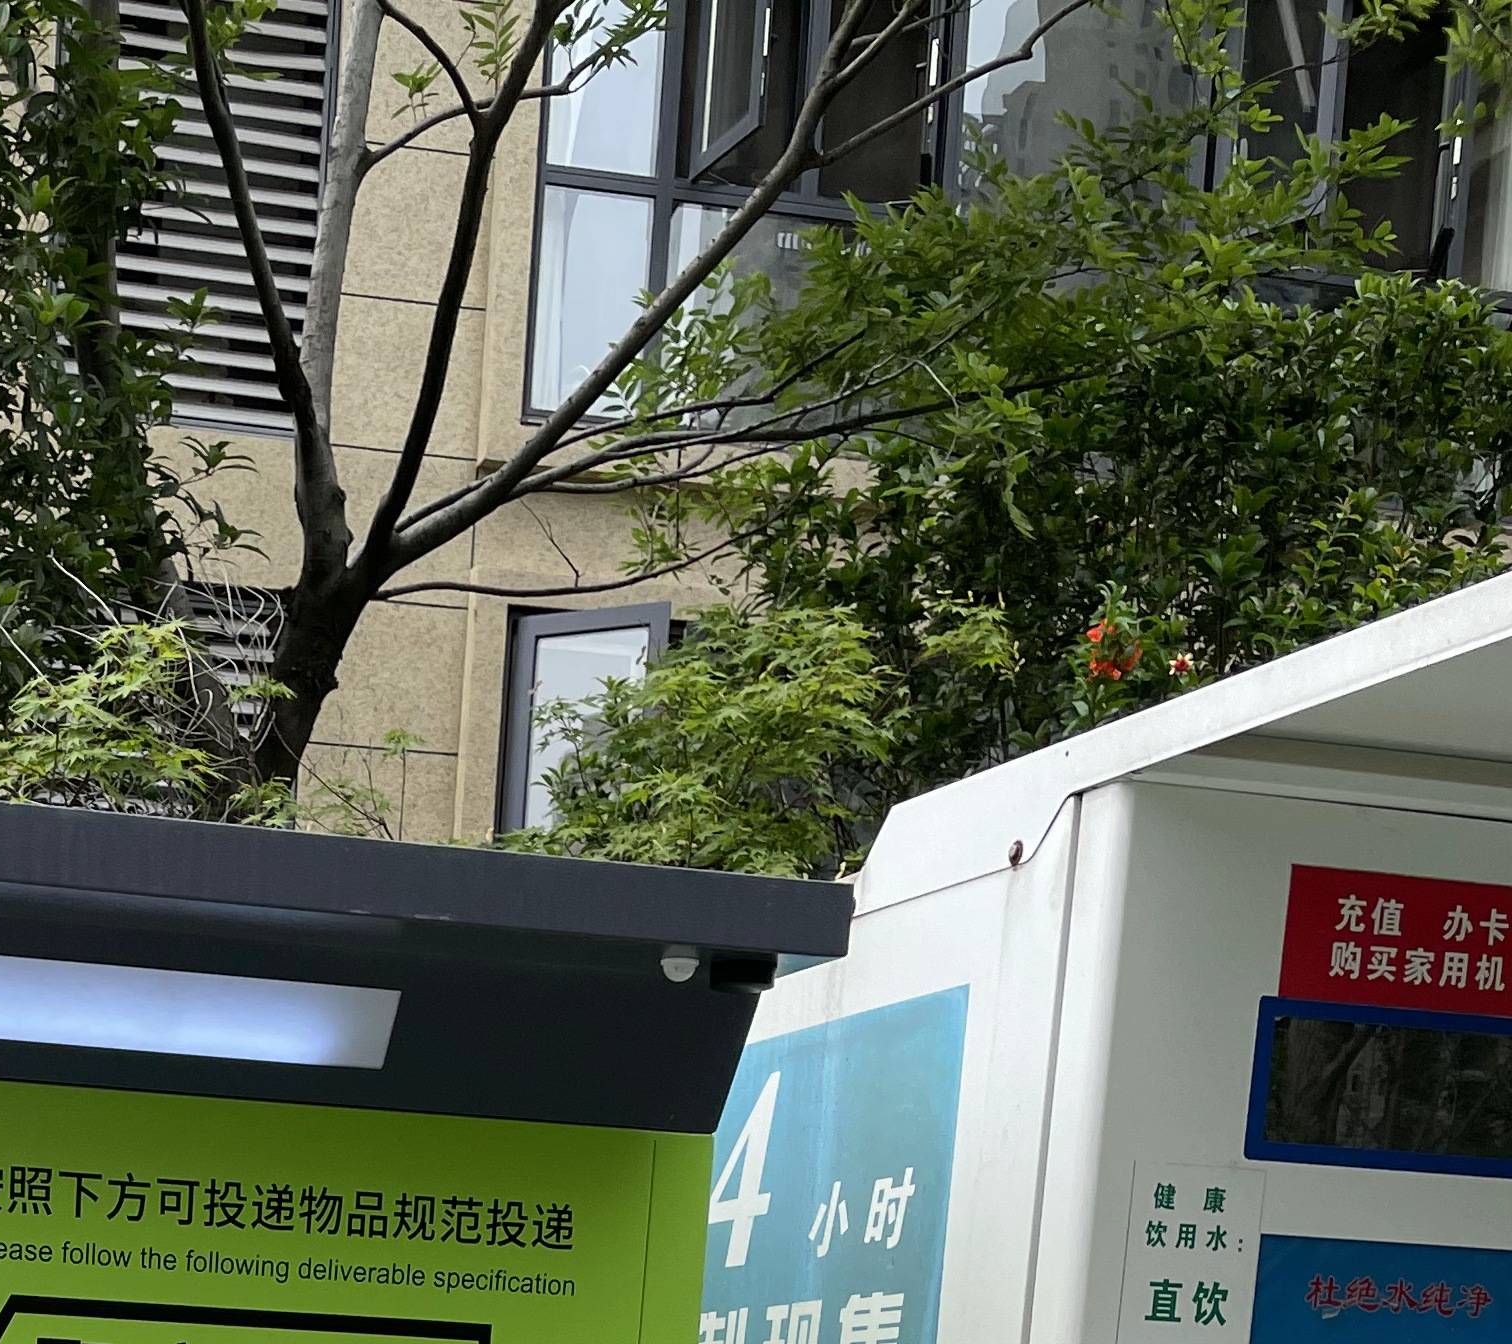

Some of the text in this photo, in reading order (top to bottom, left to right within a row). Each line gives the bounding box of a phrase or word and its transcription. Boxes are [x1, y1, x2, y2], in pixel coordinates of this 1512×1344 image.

[1335, 894, 1510, 946] 充值 办卡
[1328, 941, 1506, 992] 购买家用机
[808, 1167, 916, 1259] 小时
[1153, 1182, 1227, 1214] 健康
[61, 1240, 132, 1269] follow
[140, 1246, 178, 1271] the
[185, 1248, 290, 1283] following
[297, 1256, 426, 1288] deliverable
[432, 1265, 576, 1297] specification
[1144, 1278, 1229, 1327] 直饮
